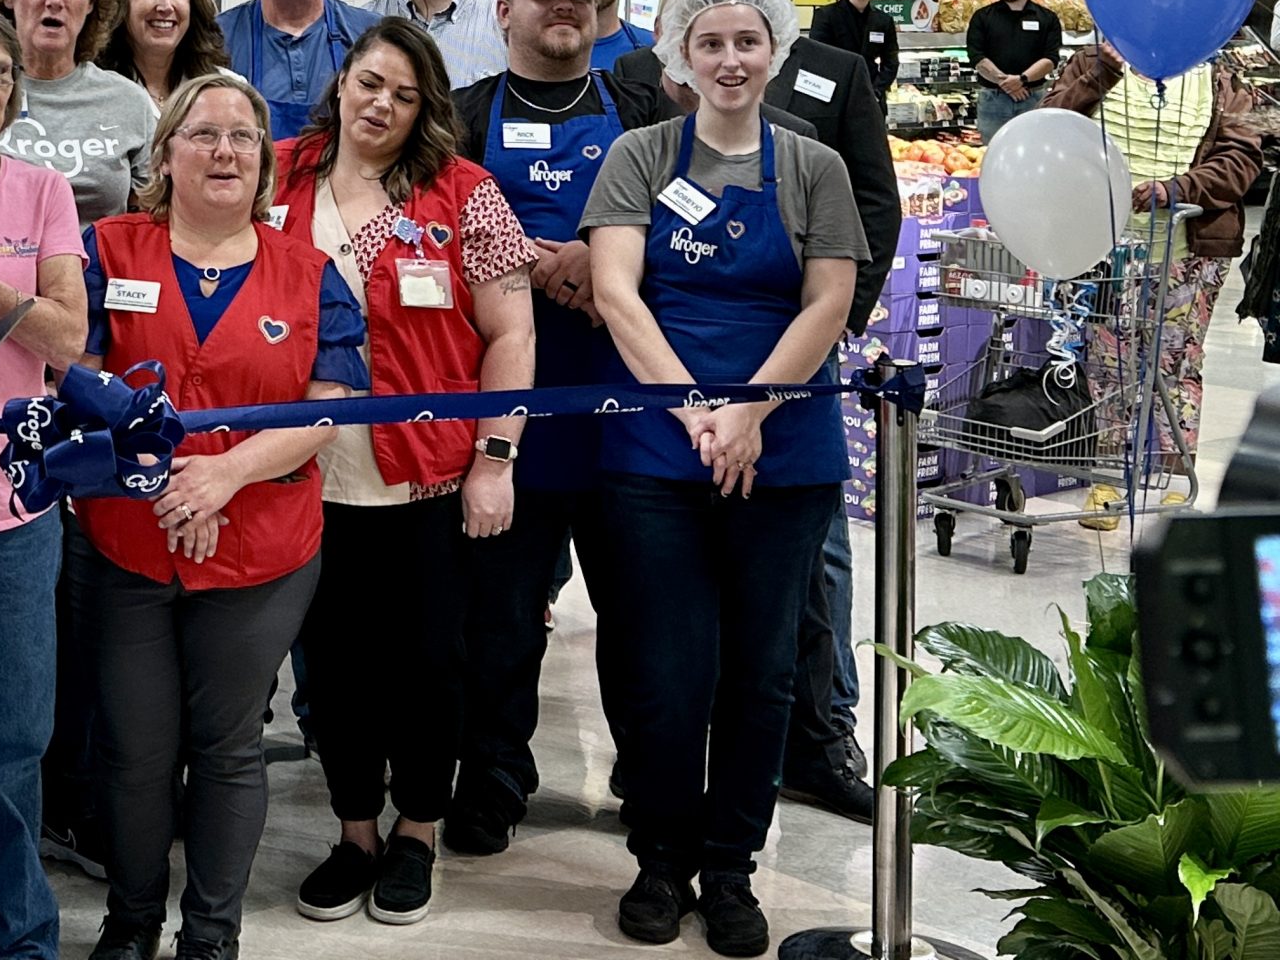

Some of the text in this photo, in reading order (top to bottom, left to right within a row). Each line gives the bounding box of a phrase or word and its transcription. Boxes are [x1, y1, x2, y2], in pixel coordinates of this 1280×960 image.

[883, 4, 904, 14] CHEF
[529, 160, 574, 191] Kroger
[670, 227, 718, 265] Kroger
[116, 290, 147, 300] STACEY
[919, 303, 939, 315] FARM
[918, 314, 940, 326] FRESH
[919, 342, 939, 353] FARM
[918, 353, 940, 363] FRESH
[16, 397, 52, 451] Kroge
[918, 455, 938, 467] FARM
[917, 466, 939, 478] FRESH
